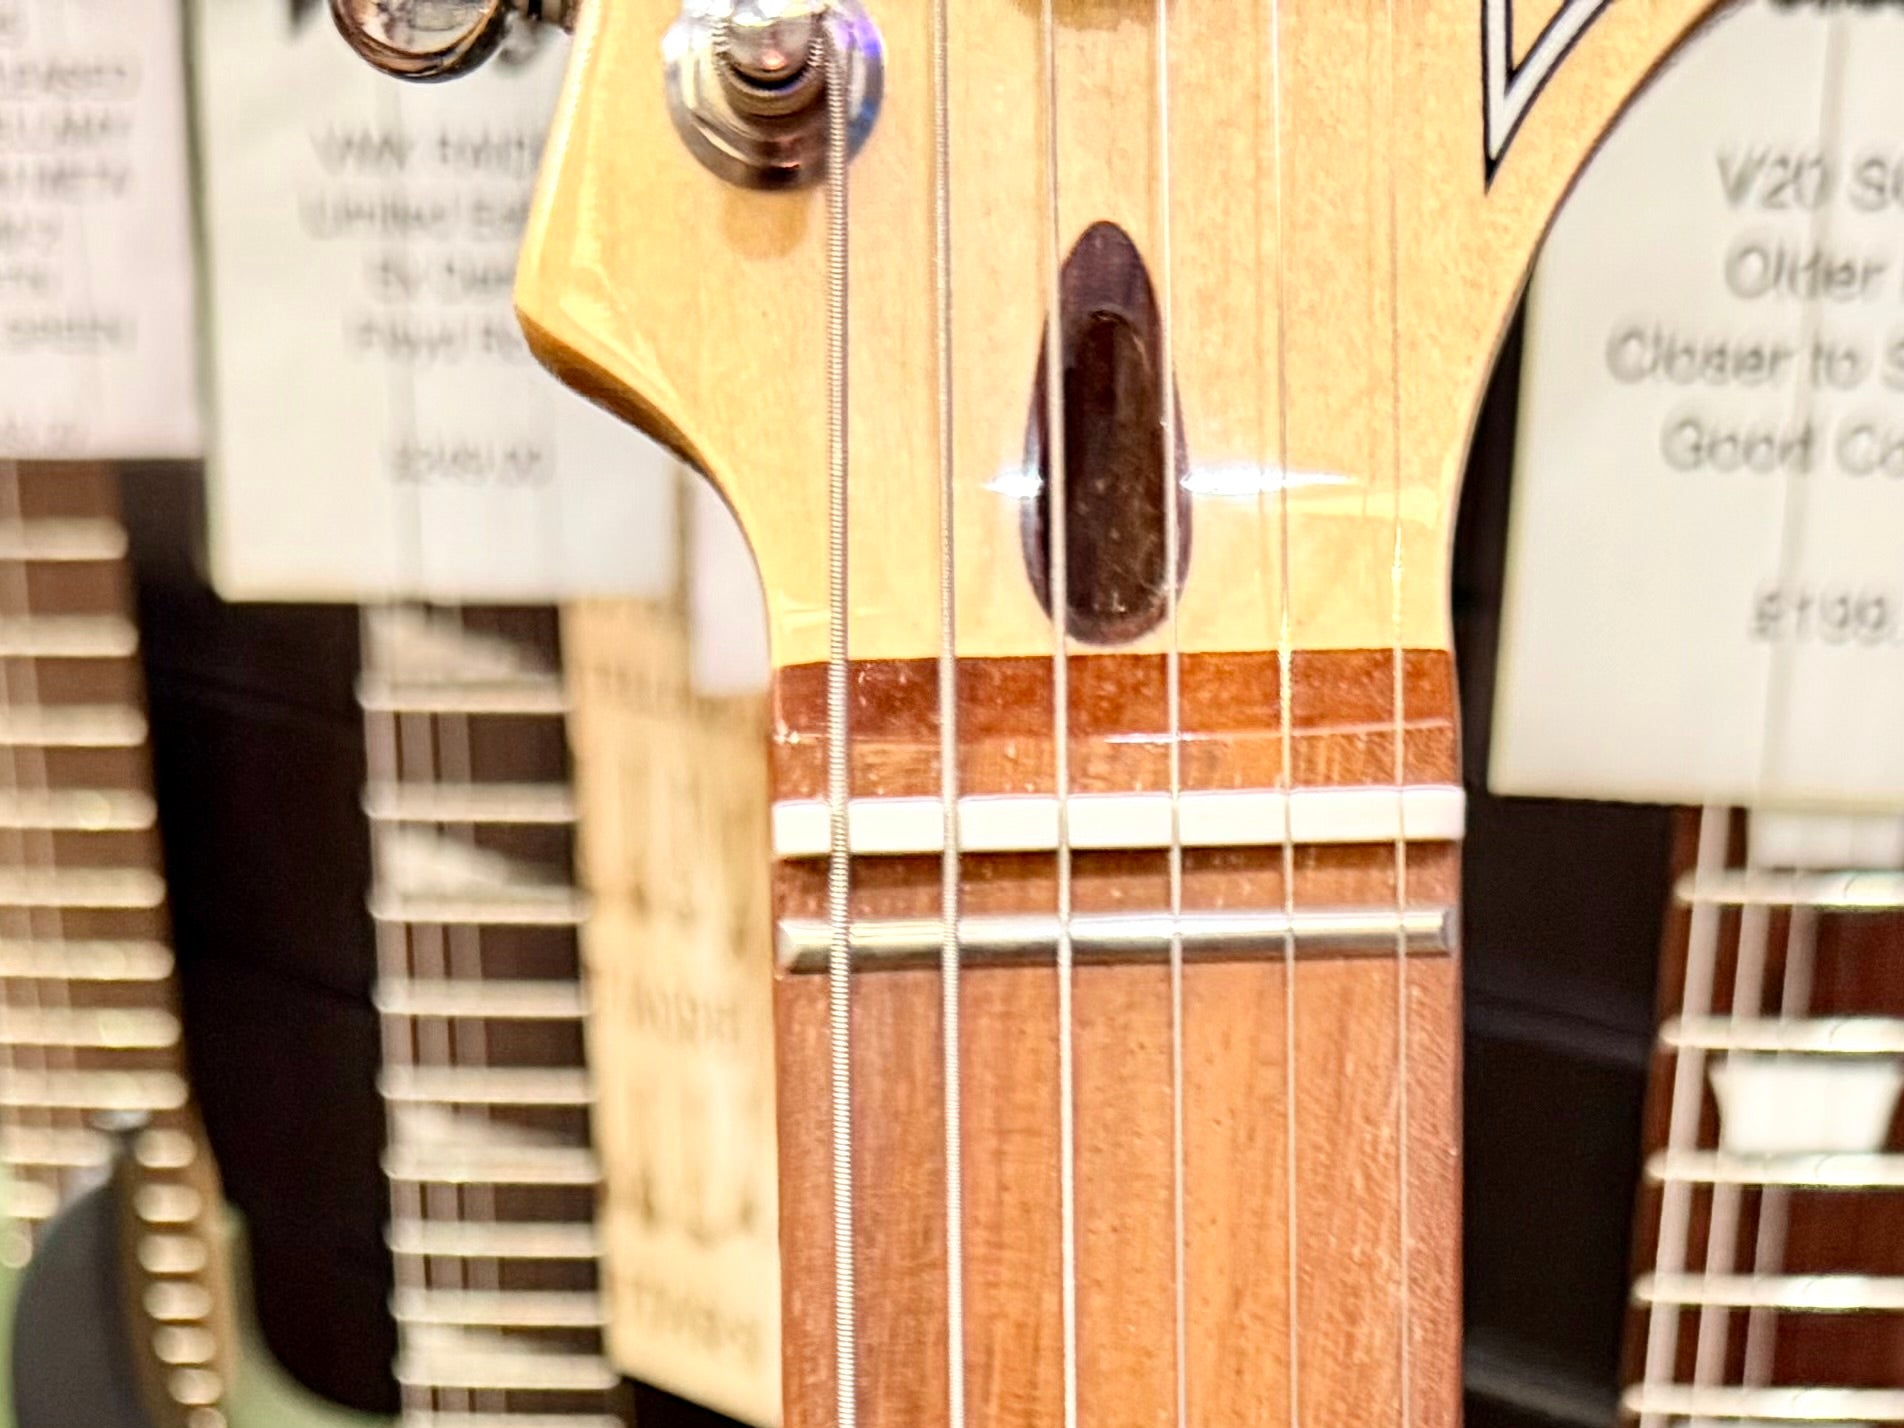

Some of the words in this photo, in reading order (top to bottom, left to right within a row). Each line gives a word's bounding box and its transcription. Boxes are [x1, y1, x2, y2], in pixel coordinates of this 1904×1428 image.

[1724, 238, 1886, 301] Older
[1605, 320, 1793, 385] Closer
[1811, 339, 1869, 390] to
[1660, 414, 1815, 473] Good
